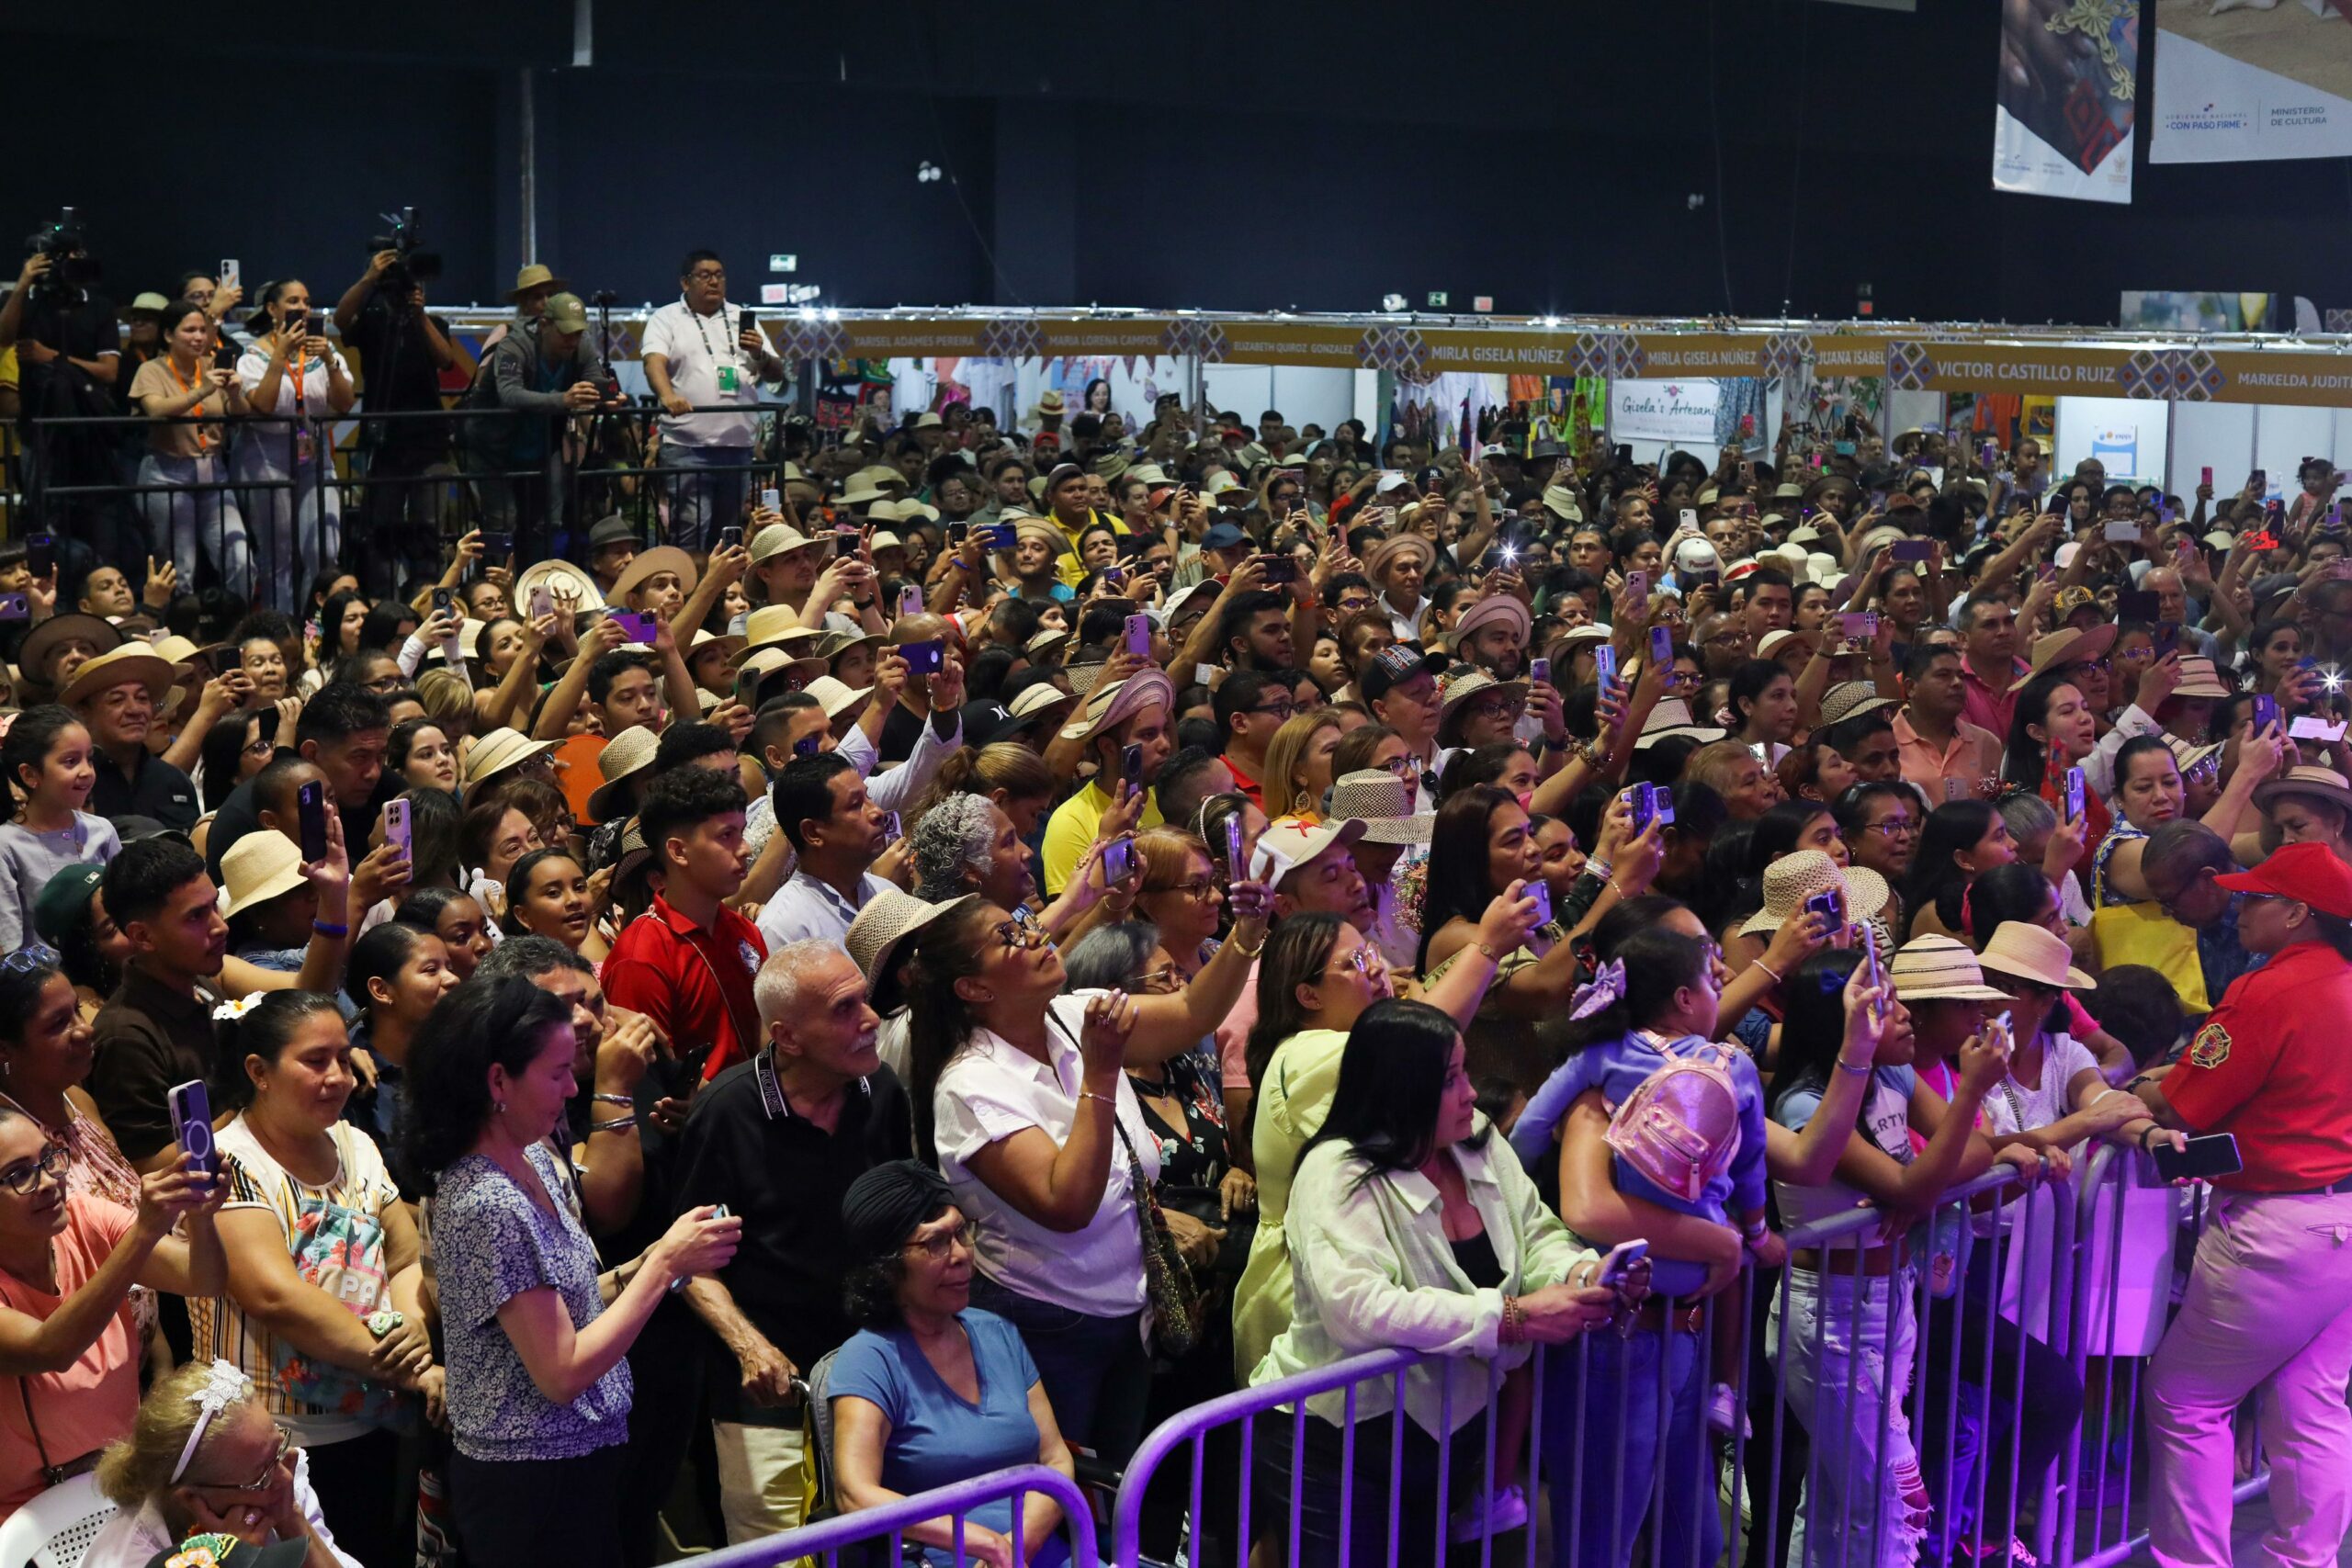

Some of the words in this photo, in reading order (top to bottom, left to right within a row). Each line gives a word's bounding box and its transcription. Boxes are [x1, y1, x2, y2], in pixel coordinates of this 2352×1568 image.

[2271, 107, 2324, 116] MINISTERIO
[2170, 121, 2190, 130] CON
[2193, 121, 2215, 130] PASO
[2217, 120, 2241, 129] FIRME
[2271, 118, 2281, 127] DE
[2285, 117, 2327, 126] CULTURA
[895, 336, 934, 346] ADAMES
[936, 335, 975, 346] PEREIRA
[1081, 335, 1118, 345] LORENA
[1120, 335, 1159, 345] CAMPOS
[1234, 341, 1275, 351] ELIZABETH
[1276, 343, 1307, 354] QUIROZ
[1311, 344, 1354, 355] GONZALEZ
[1431, 345, 1469, 360] MIRLA
[1473, 347, 1514, 362] GISELA
[1518, 345, 1564, 364] NÚÑEZ
[1647, 351, 1680, 367] MIRLA
[1683, 351, 1719, 366] GISELA
[1720, 348, 1757, 366] NÚÑEZ
[1818, 351, 1851, 365] JUANA
[1853, 350, 1886, 365] ISABEL
[1937, 360, 1994, 378] VICTOR
[1998, 363, 2071, 382] CASTILLO
[2076, 366, 2115, 383] RUIZ
[2238, 372, 2308, 387] MARKELDA
[1623, 396, 1664, 414] Gisela's
[1669, 398, 1716, 416] Artesani
[759, 1068, 782, 1112] KORS
